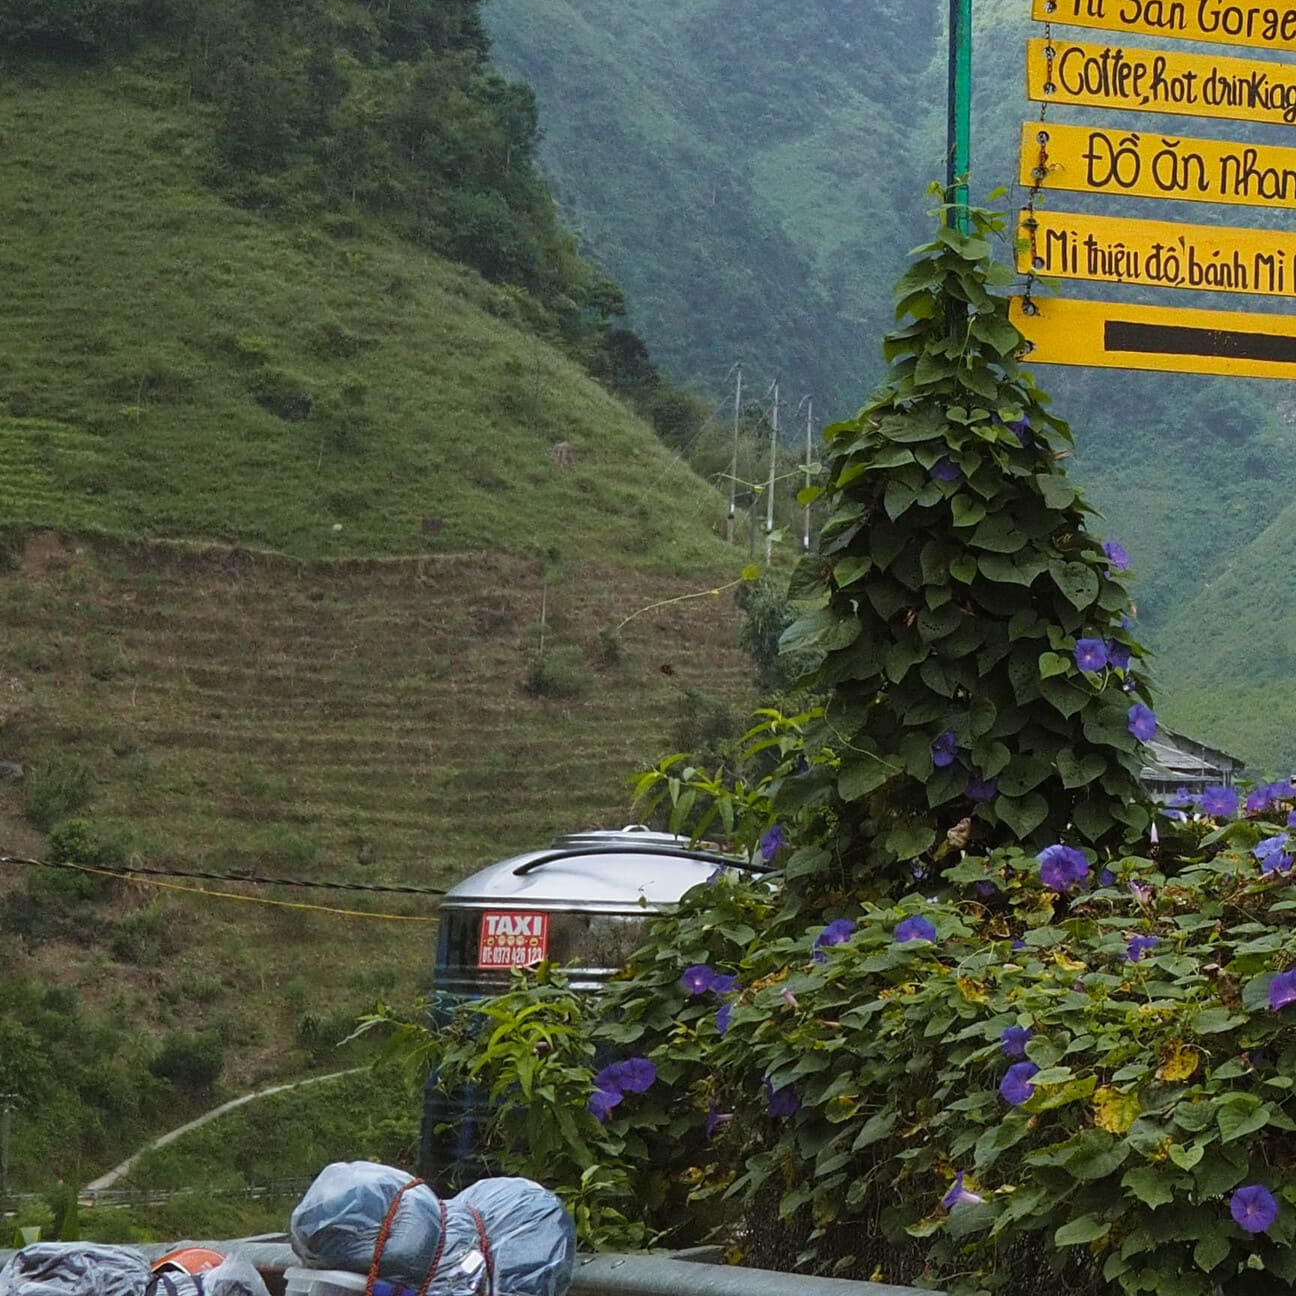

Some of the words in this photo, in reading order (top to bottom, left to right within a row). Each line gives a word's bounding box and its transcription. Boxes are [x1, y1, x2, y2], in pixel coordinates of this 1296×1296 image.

[1082, 132, 1141, 188] Đồ
[1152, 139, 1209, 191] ăn
[1046, 229, 1077, 273] Mì
[1189, 246, 1248, 289] bánh
[1254, 250, 1285, 292] Mì
[486, 915, 542, 936] TAXI
